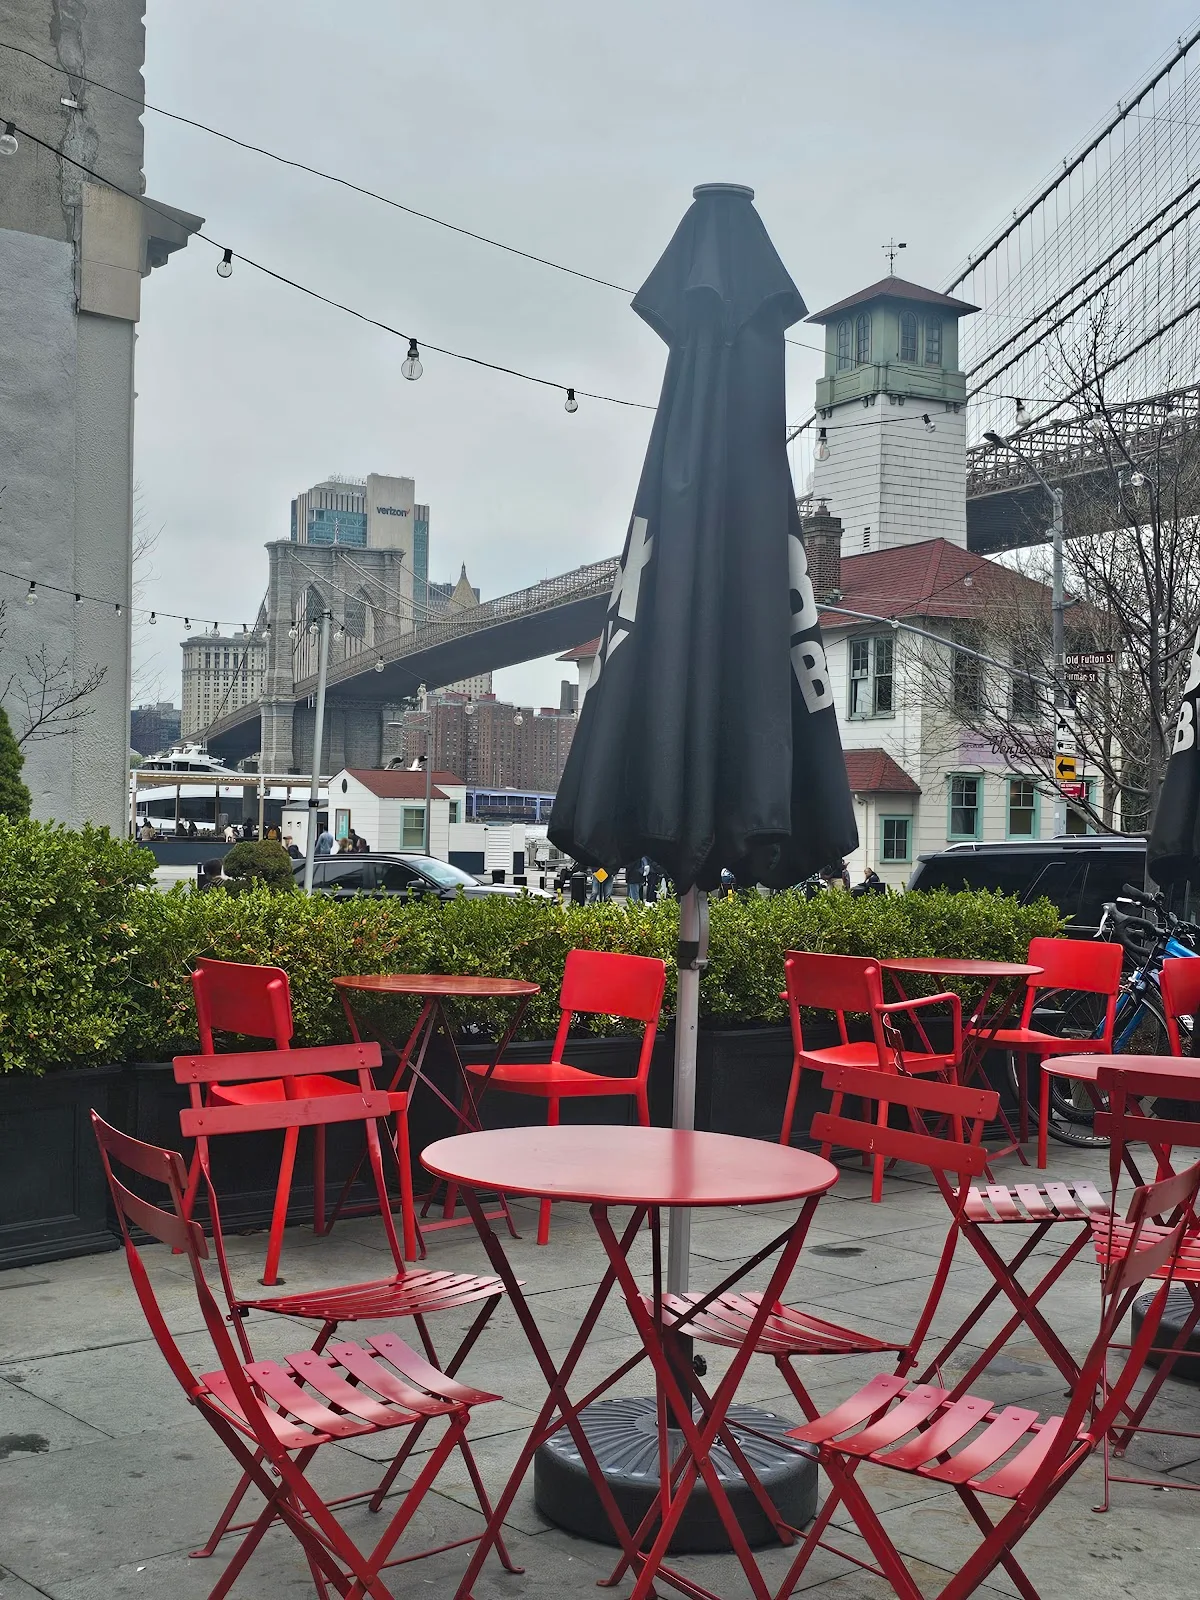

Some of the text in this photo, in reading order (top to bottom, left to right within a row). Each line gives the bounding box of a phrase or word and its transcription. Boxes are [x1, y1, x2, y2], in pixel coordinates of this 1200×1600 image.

[376, 506, 407, 518] verizon
[1066, 654, 1114, 665] Old Fulton St
[1089, 673, 1096, 682] St
